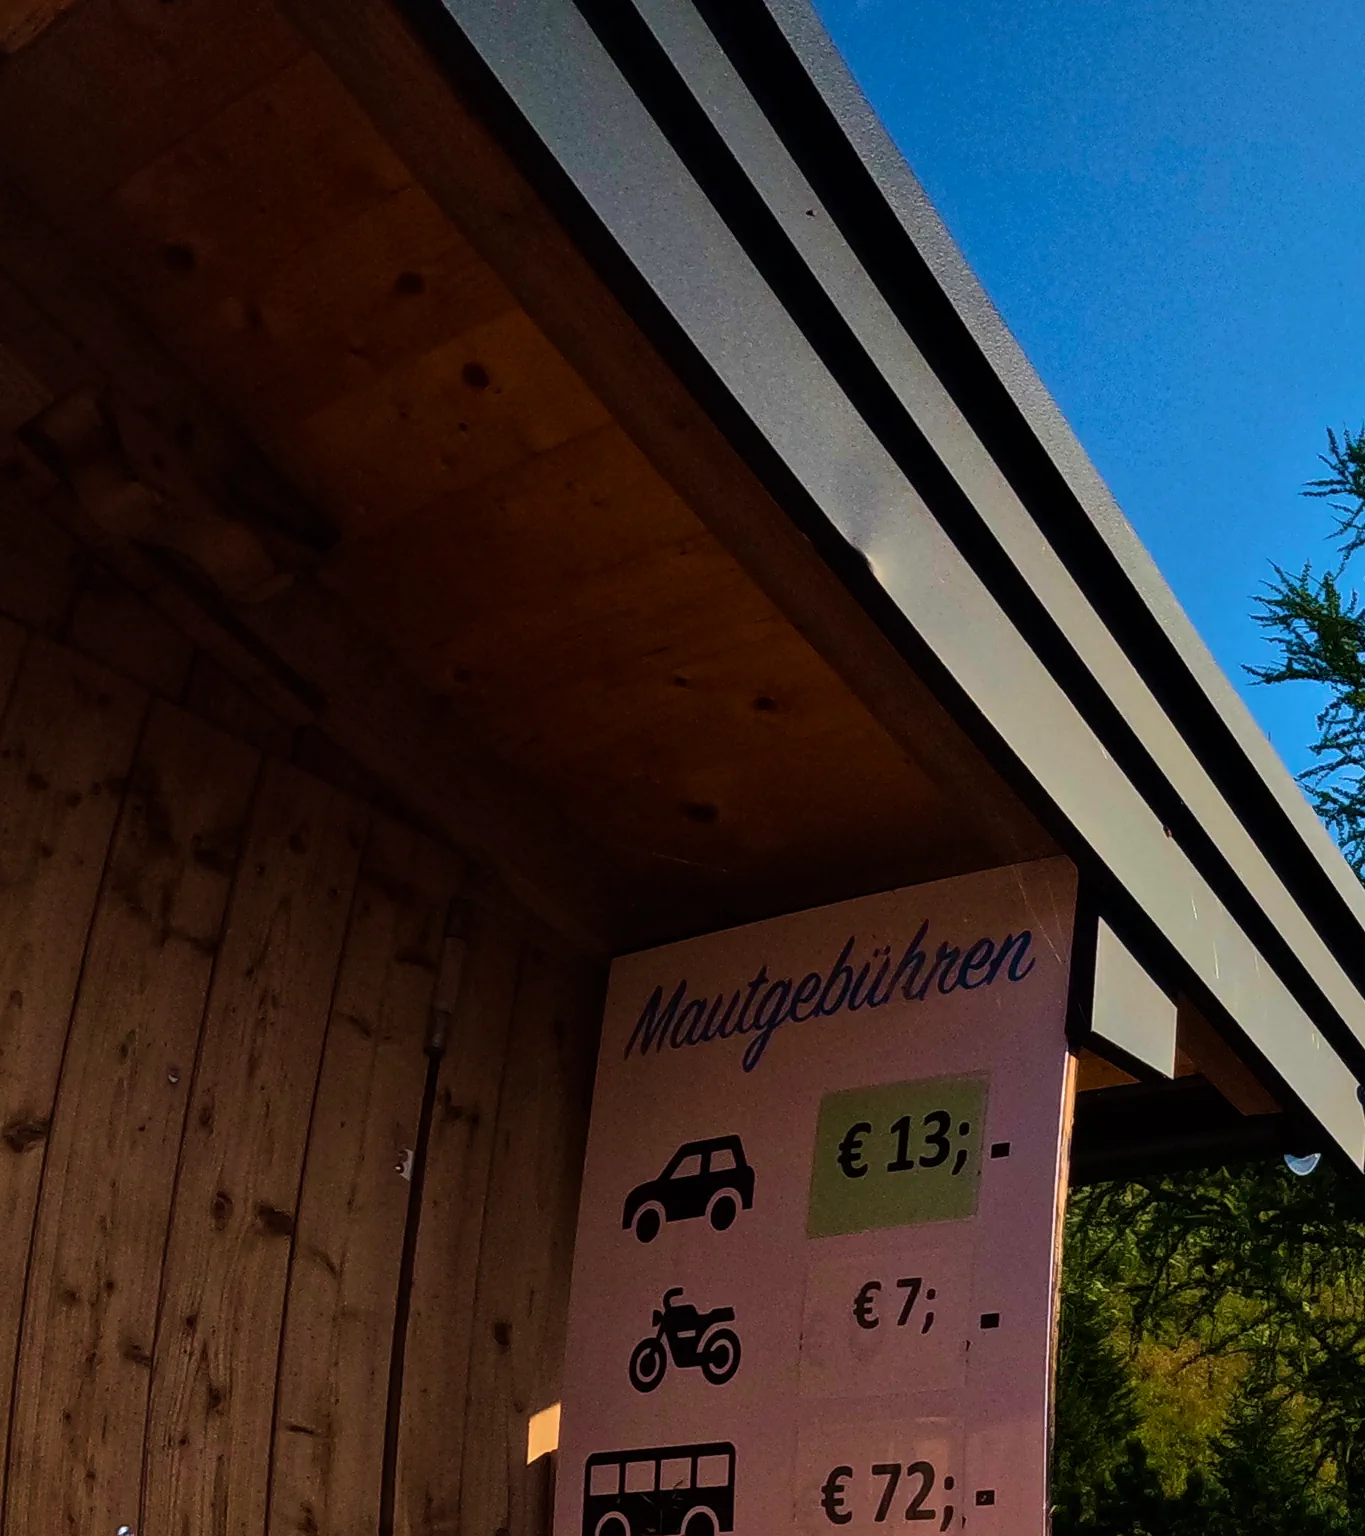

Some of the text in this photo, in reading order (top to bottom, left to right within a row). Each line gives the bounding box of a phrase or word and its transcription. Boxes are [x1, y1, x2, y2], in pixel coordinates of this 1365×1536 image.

[624, 919, 1036, 1073] Mautgebühren
[837, 1122, 872, 1178] €
[853, 1281, 882, 1329] €
[821, 1466, 853, 1524] €
